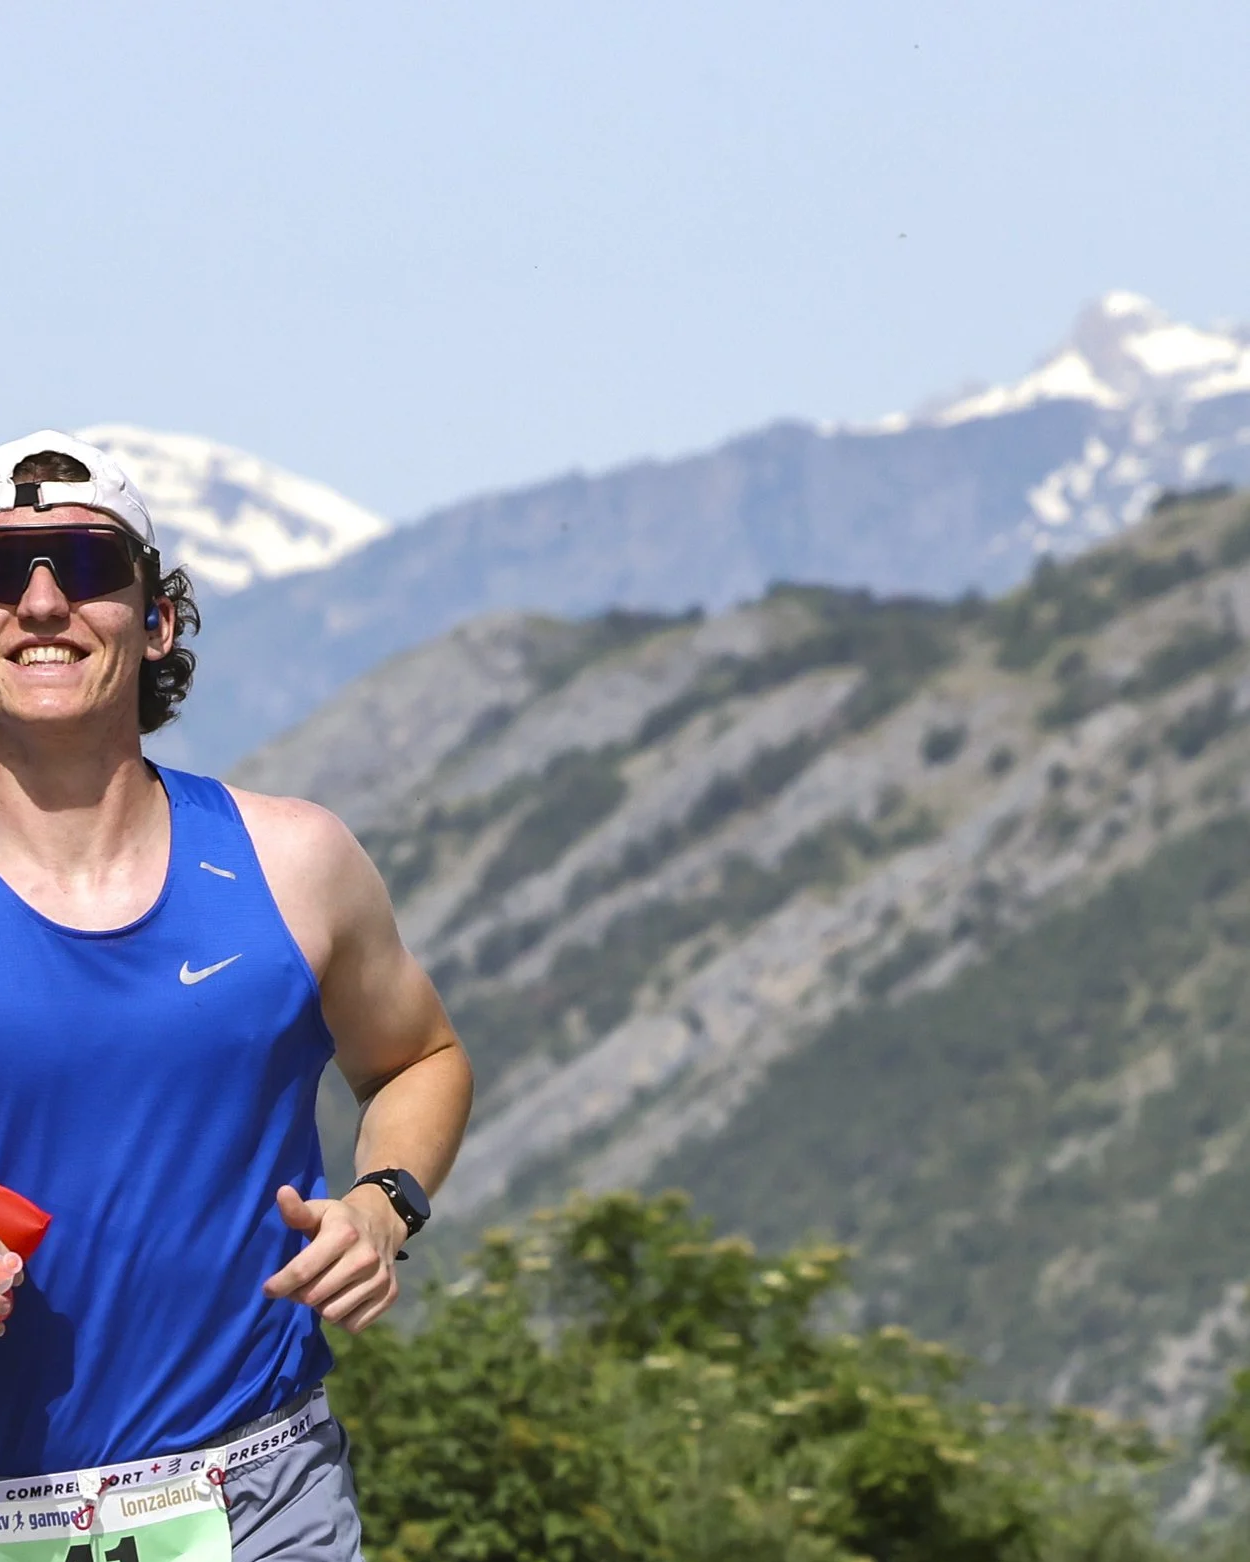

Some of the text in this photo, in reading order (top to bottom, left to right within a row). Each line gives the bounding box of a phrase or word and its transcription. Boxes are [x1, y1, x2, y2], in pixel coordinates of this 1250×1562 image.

[190, 1414, 311, 1472] CPRESSPORT
[120, 1479, 199, 1517] lonzalauf
[29, 1506, 85, 1529] gampel
